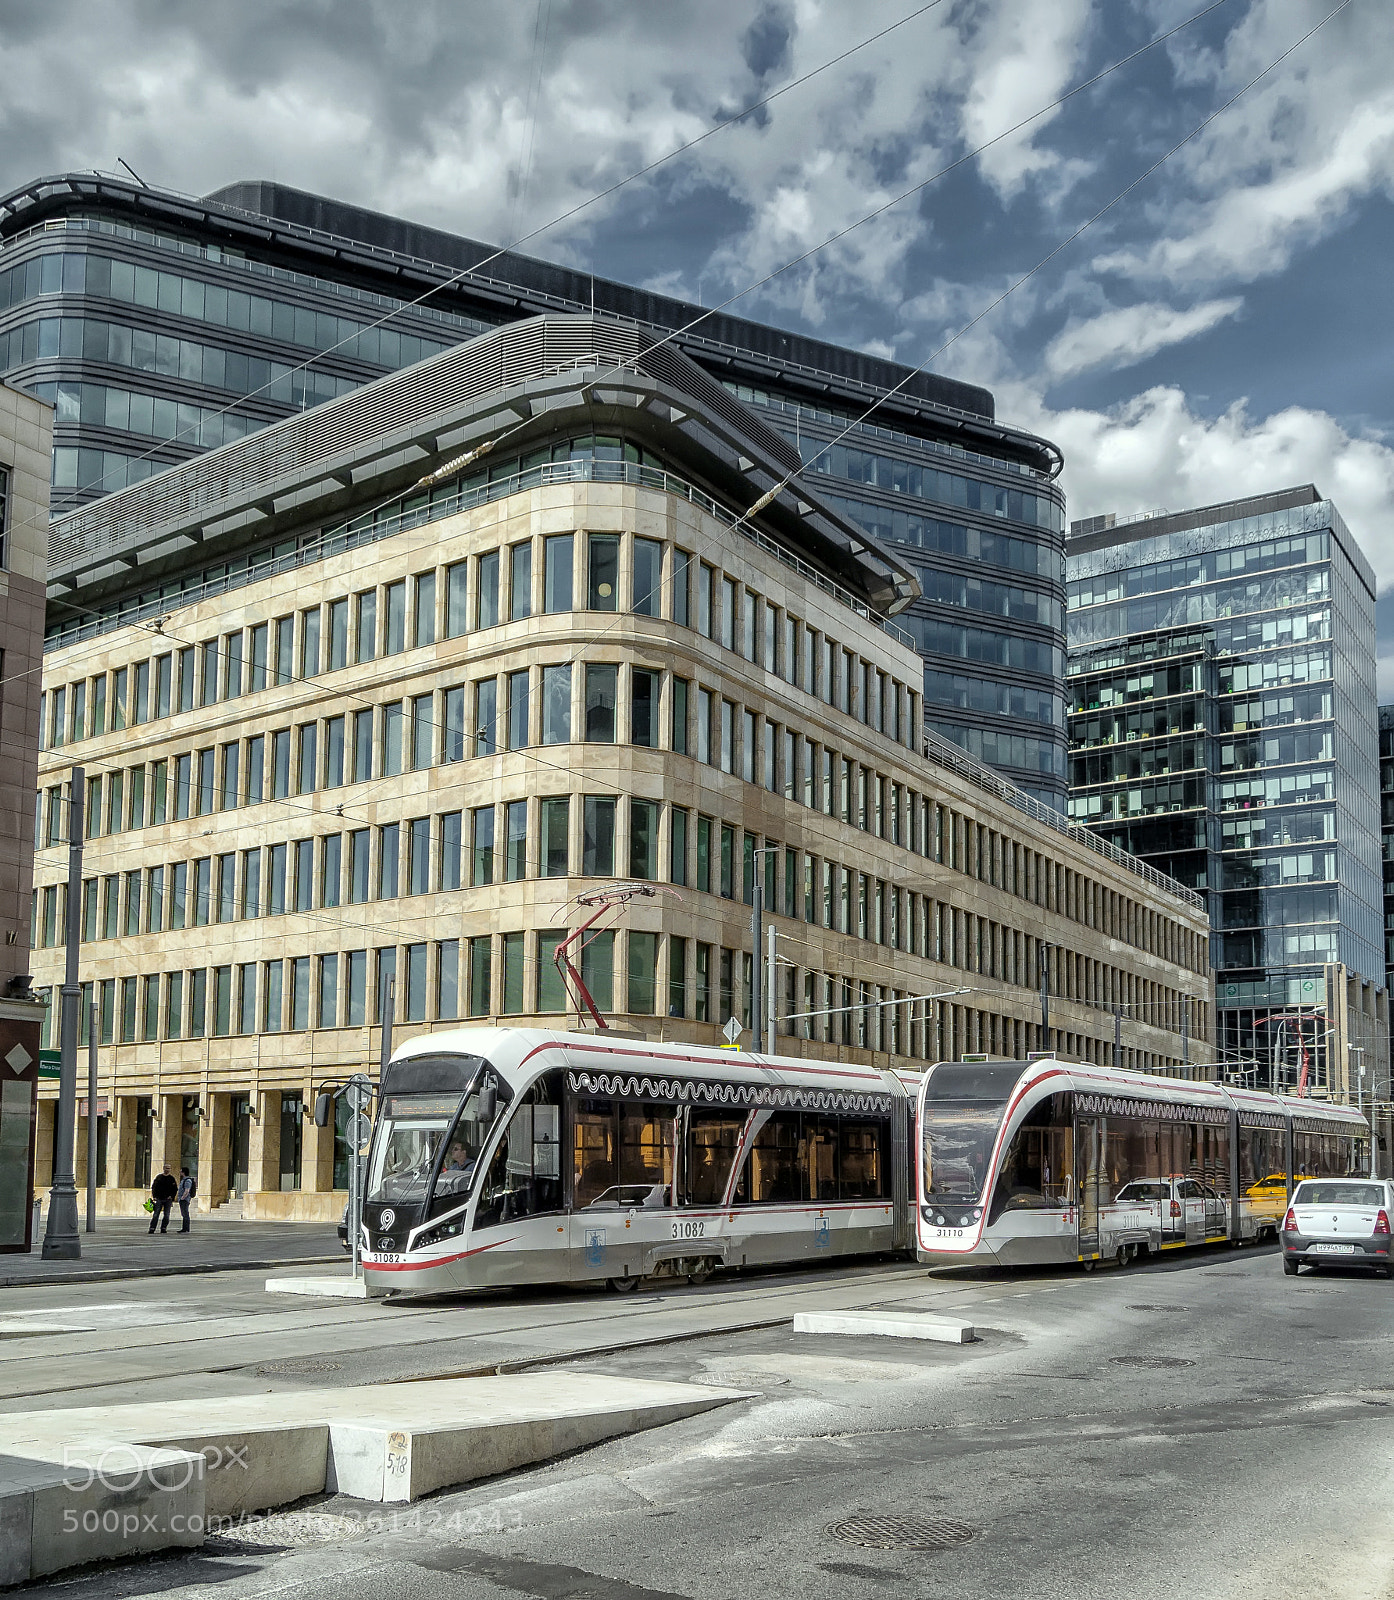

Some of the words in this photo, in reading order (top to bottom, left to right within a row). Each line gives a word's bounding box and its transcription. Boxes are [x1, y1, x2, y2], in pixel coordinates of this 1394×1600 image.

[672, 1221, 705, 1238] 31082
[936, 1229, 963, 1237] 31110
[373, 1253, 400, 1263] 31082
